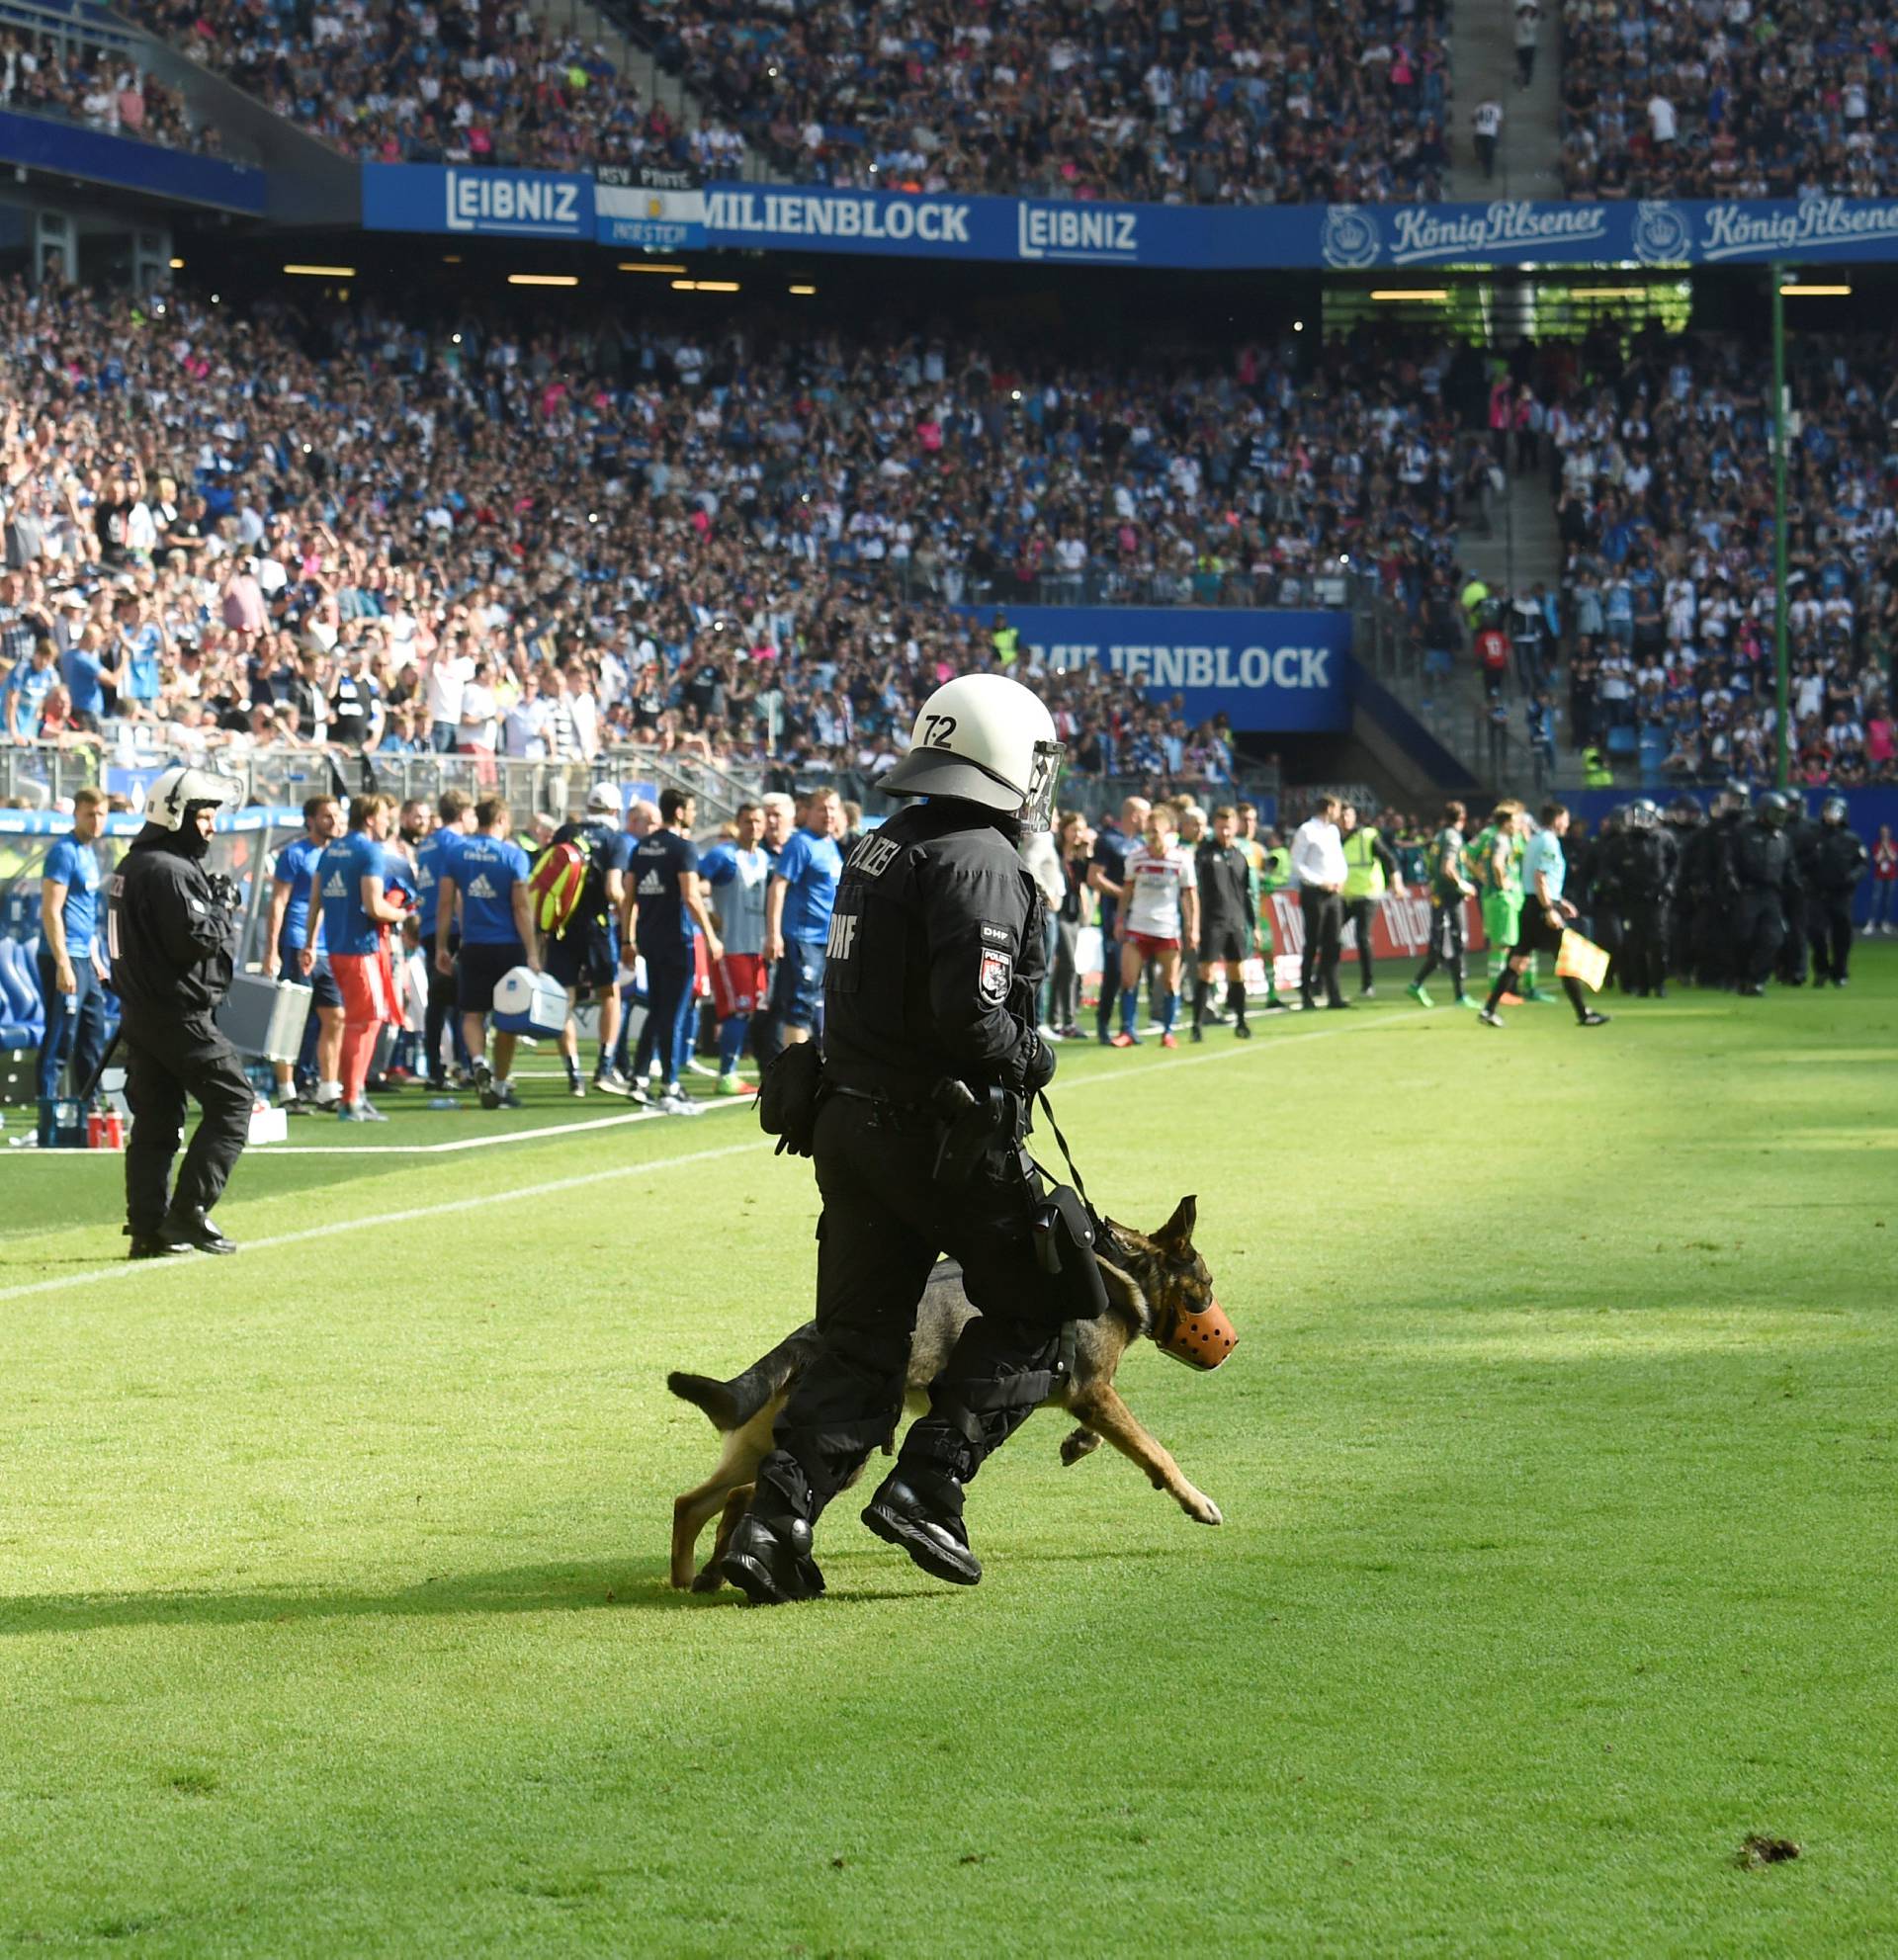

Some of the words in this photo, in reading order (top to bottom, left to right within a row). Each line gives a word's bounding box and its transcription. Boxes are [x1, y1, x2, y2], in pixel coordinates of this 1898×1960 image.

[446, 170, 578, 230] LEIBNIZ
[1018, 201, 1137, 258] LEIBNIZ
[923, 715, 957, 749] 72
